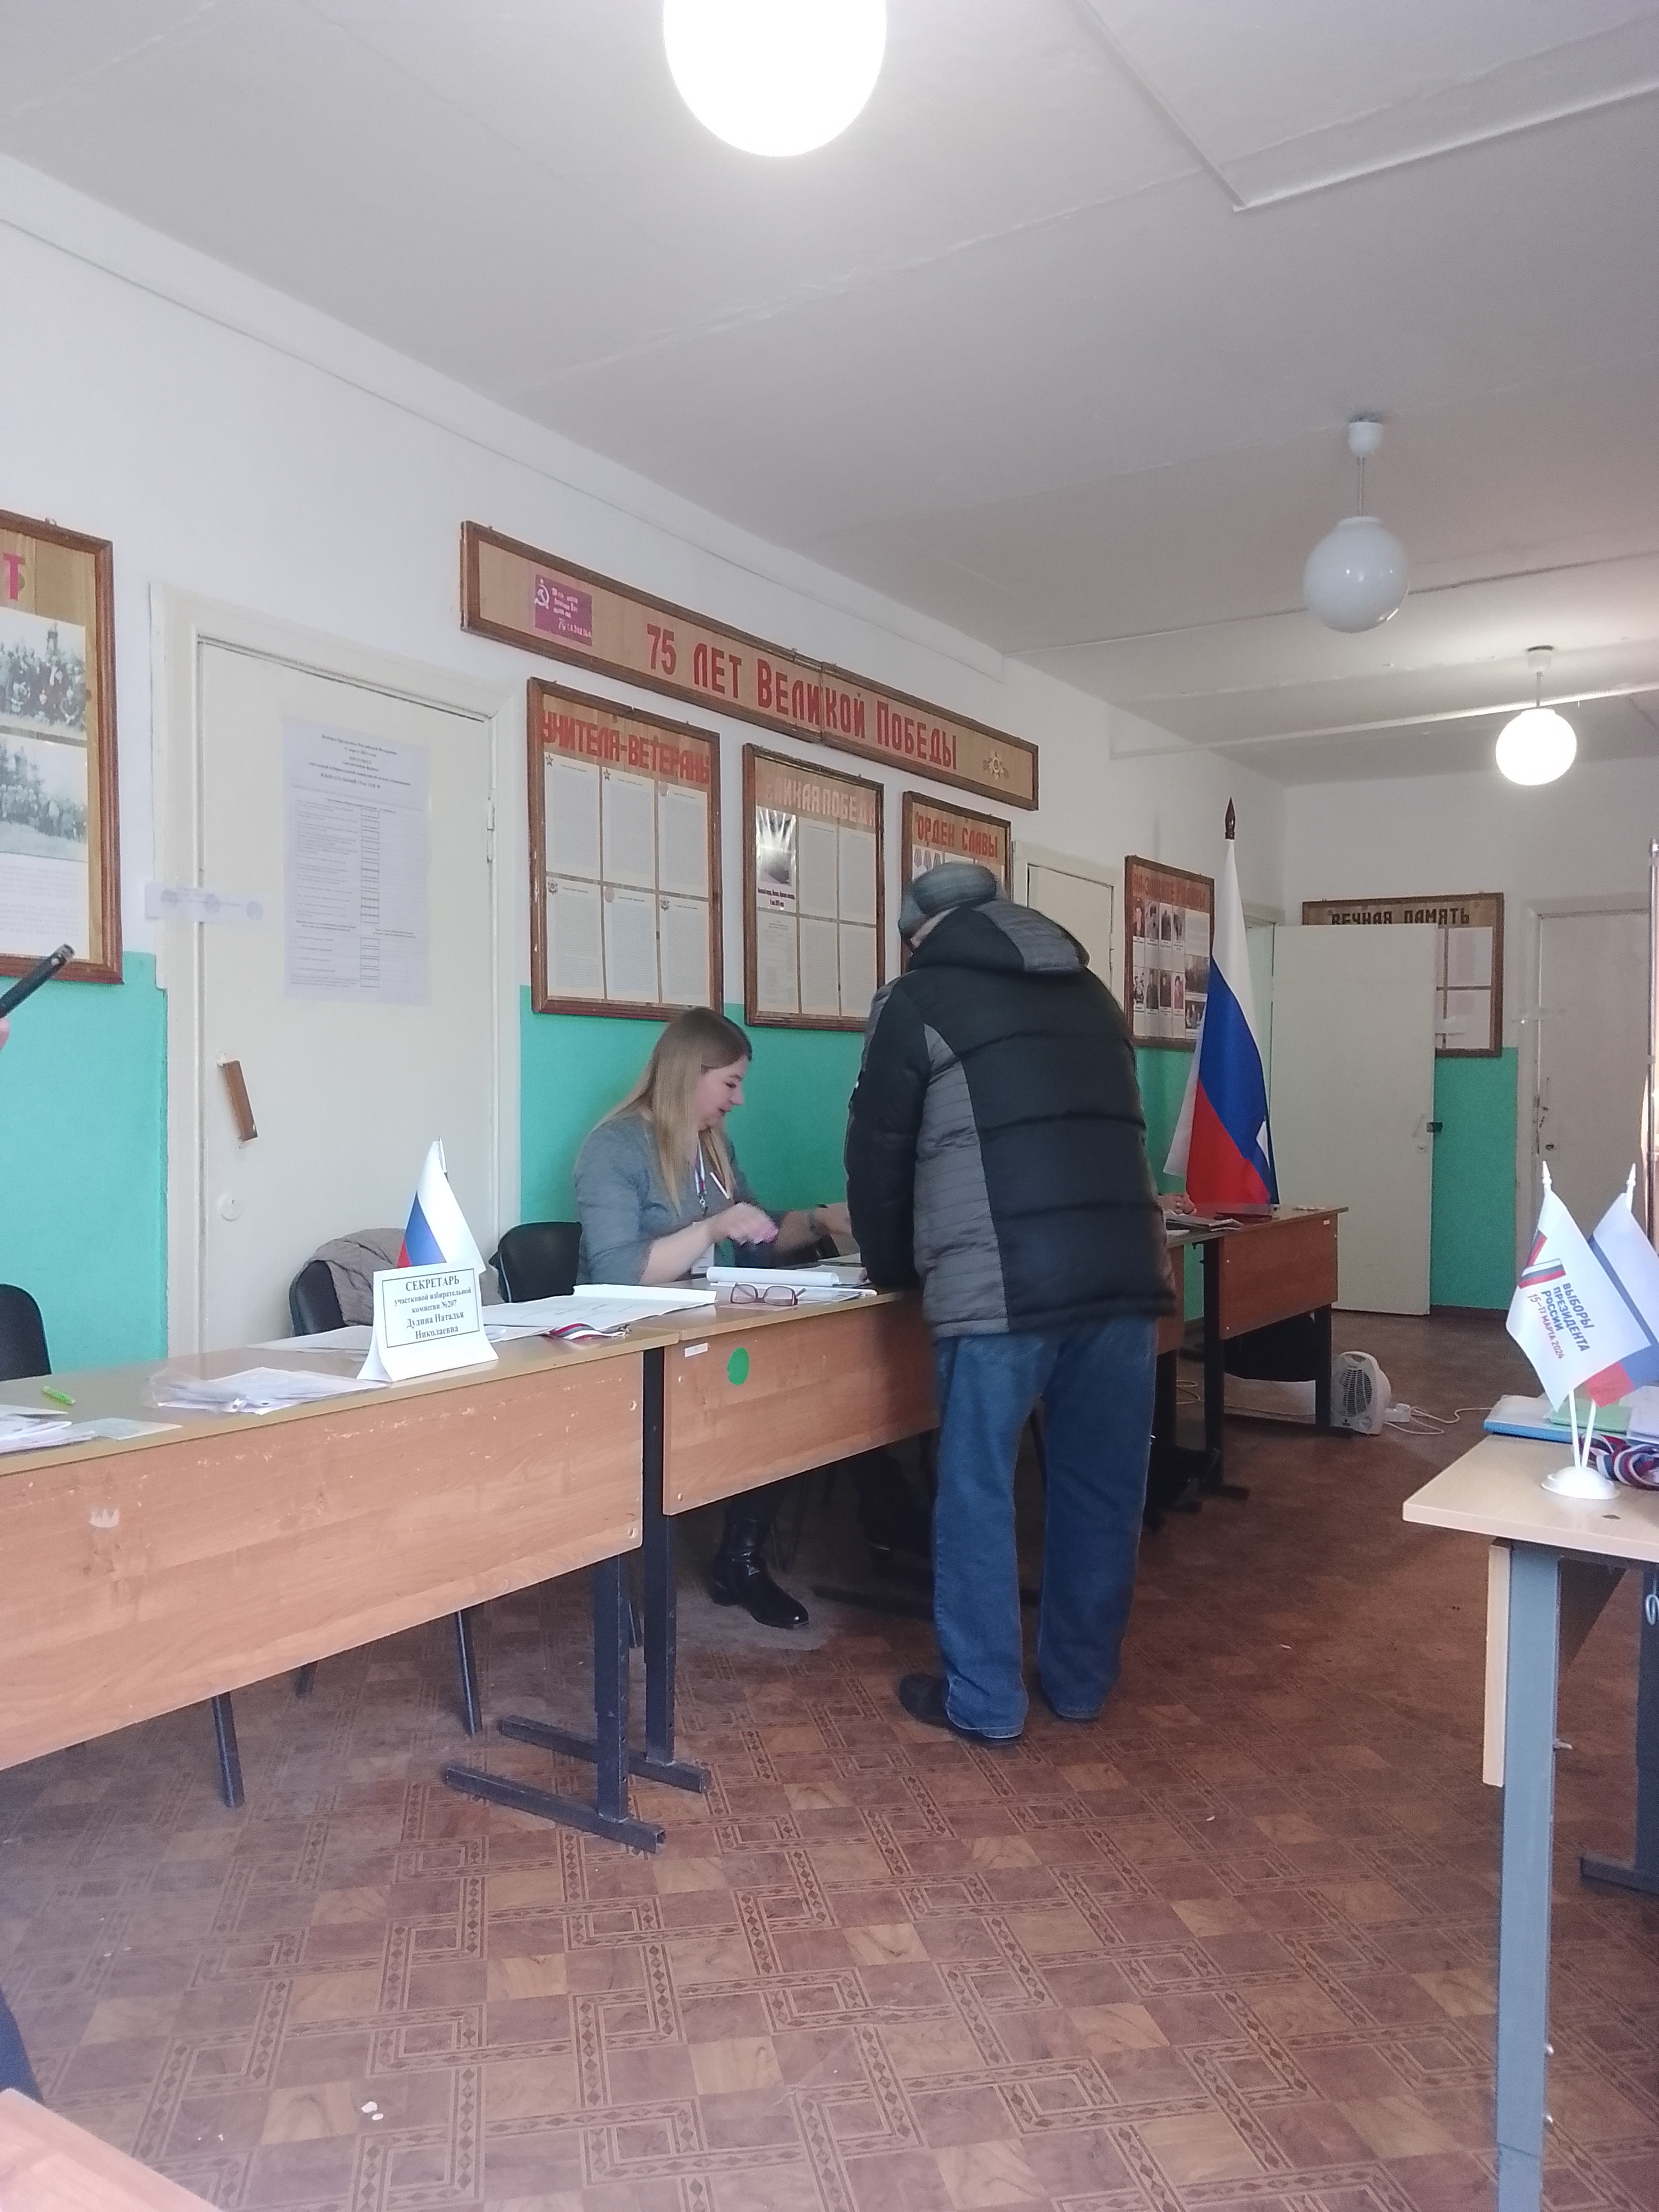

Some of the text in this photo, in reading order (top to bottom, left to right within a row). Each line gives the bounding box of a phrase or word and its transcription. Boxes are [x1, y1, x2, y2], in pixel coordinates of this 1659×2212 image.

[647, 623, 957, 770] 75 ЛЕТ ВЕЛИКОЙ ПОБЕДЫ
[764, 777, 819, 813] ЕЛИКАЯ
[917, 816, 998, 858] ОРДЕН СЛАВЫ
[1331, 908, 1470, 925] ВЕЧНАЯ ПАМЯТЬ
[394, 1287, 472, 1306] участковой избирательной
[405, 1275, 459, 1292] СЕКРЕТАРЬ
[406, 1312, 464, 1329] Дудина Наталья
[412, 1299, 457, 1313] комиссии №207
[1540, 1289, 1564, 1331] РОССИИ
[1553, 1286, 1590, 1352] ПРЕЗИДЕНТА
[1562, 1282, 1595, 1329] ВЫБОРЫ
[415, 1326, 459, 1339] Николаевна
[1541, 1314, 1556, 1342] МАРТА
[1551, 1340, 1565, 1359] 2024
